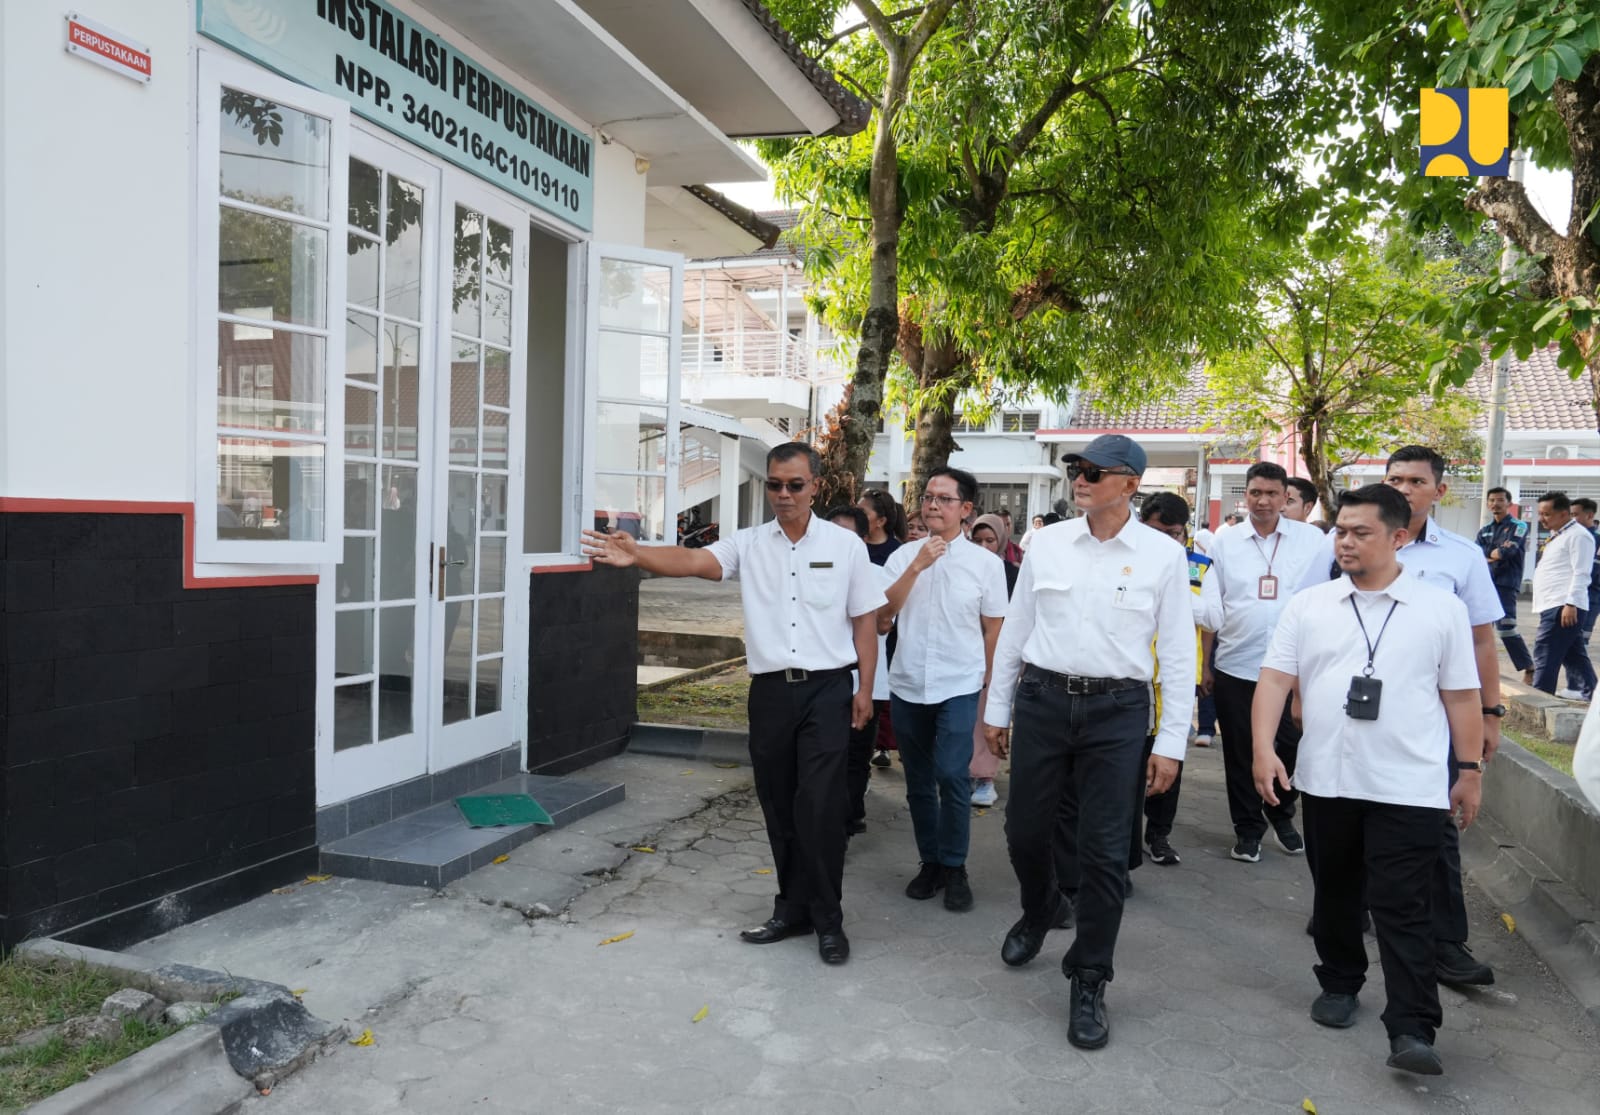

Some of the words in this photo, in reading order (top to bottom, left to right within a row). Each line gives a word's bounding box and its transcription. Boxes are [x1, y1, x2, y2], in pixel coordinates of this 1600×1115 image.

[73, 28, 147, 69] PERPUSTAKAAN
[335, 53, 394, 114] NPP.
[402, 93, 579, 212] 3402164C1019110
[452, 56, 590, 178] PERPUSTAKAAN
